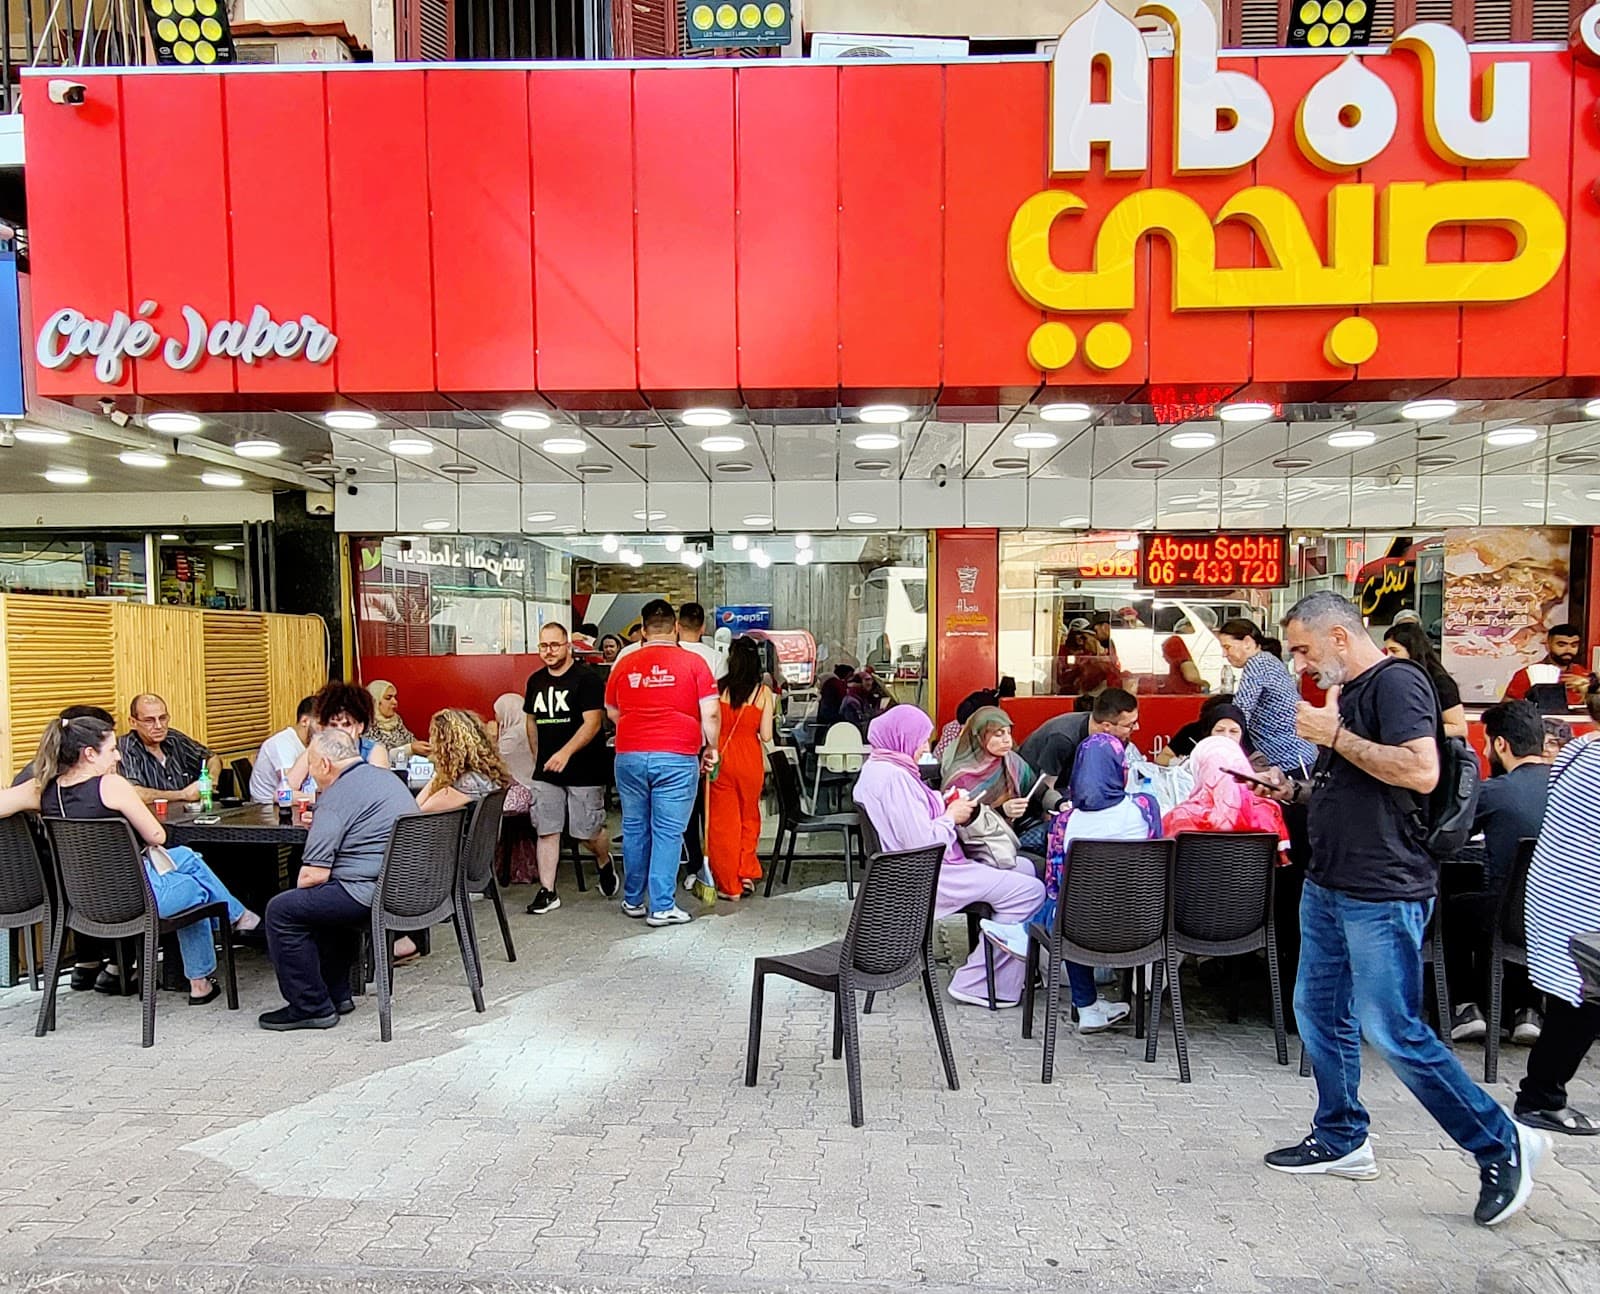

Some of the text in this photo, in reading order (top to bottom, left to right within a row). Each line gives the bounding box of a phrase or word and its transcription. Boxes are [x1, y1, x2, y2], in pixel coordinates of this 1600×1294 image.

[1049, 0, 1531, 178] Abou
[1008, 180, 1566, 372] صبحي
[36, 299, 339, 385] Café Jaber
[1148, 537, 1279, 561] Abou Sobhi
[1148, 562, 1174, 584] 06
[1192, 561, 1233, 584] 433
[1240, 561, 1278, 583] 720
[735, 613, 764, 624] pepsi
